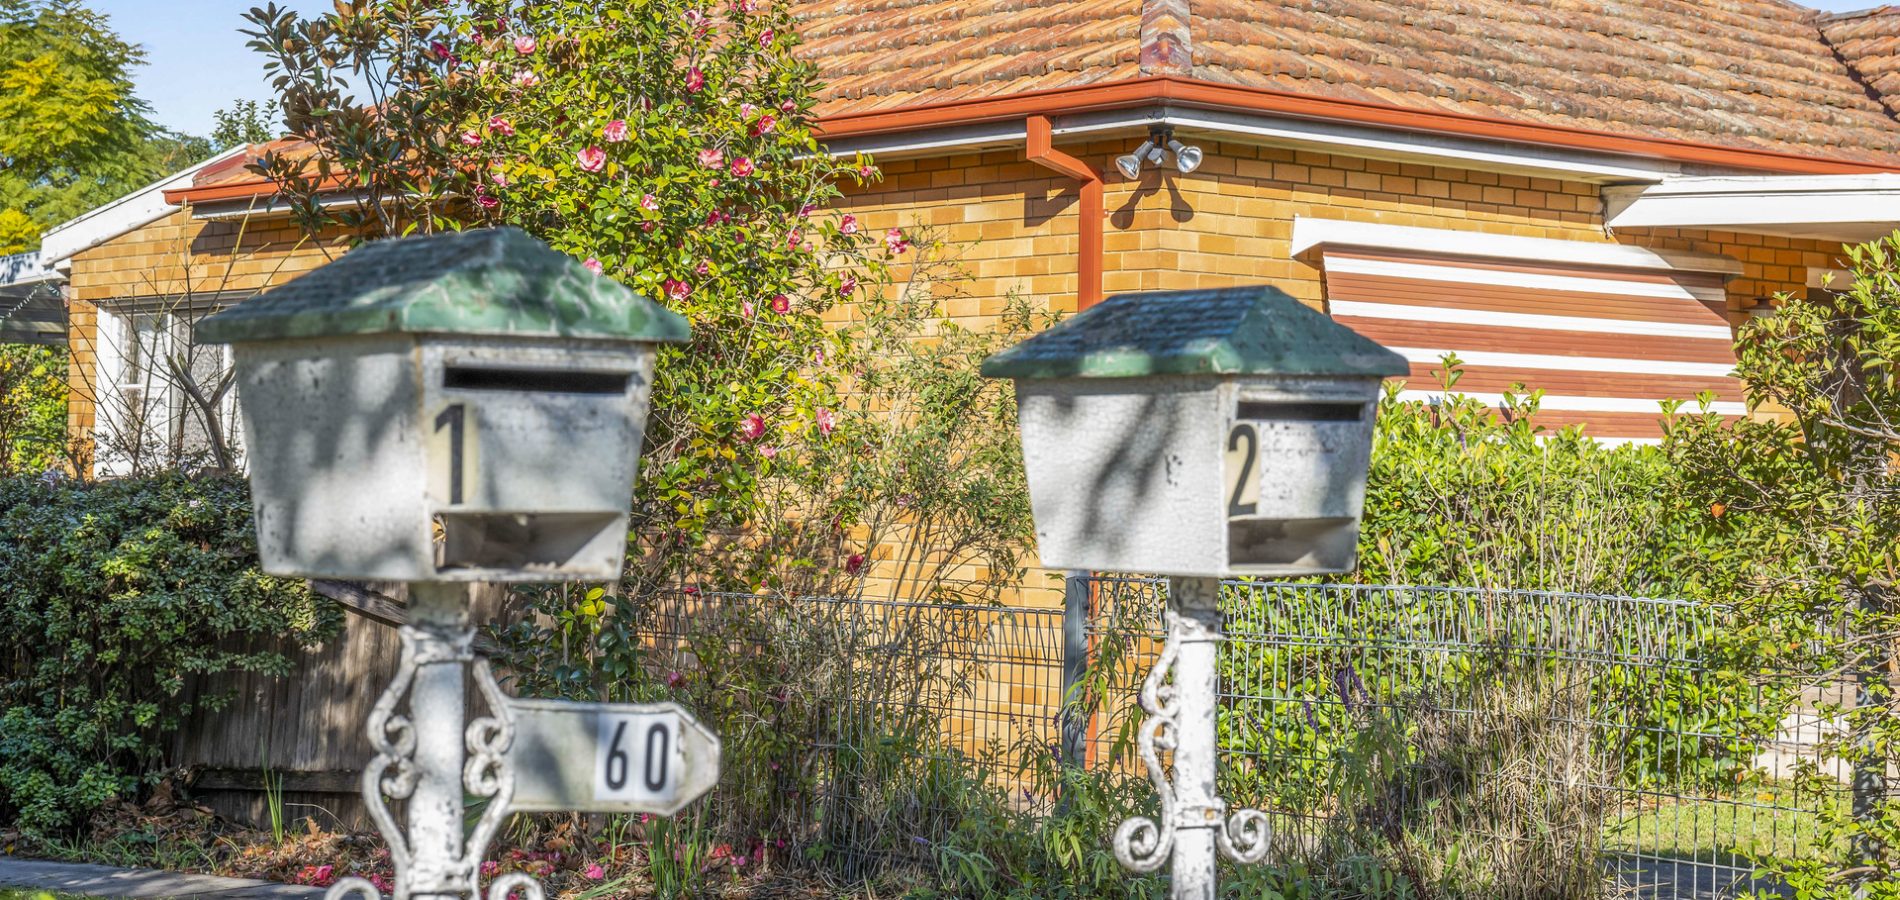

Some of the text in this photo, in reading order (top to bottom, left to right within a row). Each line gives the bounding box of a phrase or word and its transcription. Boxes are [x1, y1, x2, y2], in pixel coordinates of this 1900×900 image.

[434, 404, 465, 504] 1
[1228, 424, 1257, 517] 2
[605, 721, 669, 792] 60
